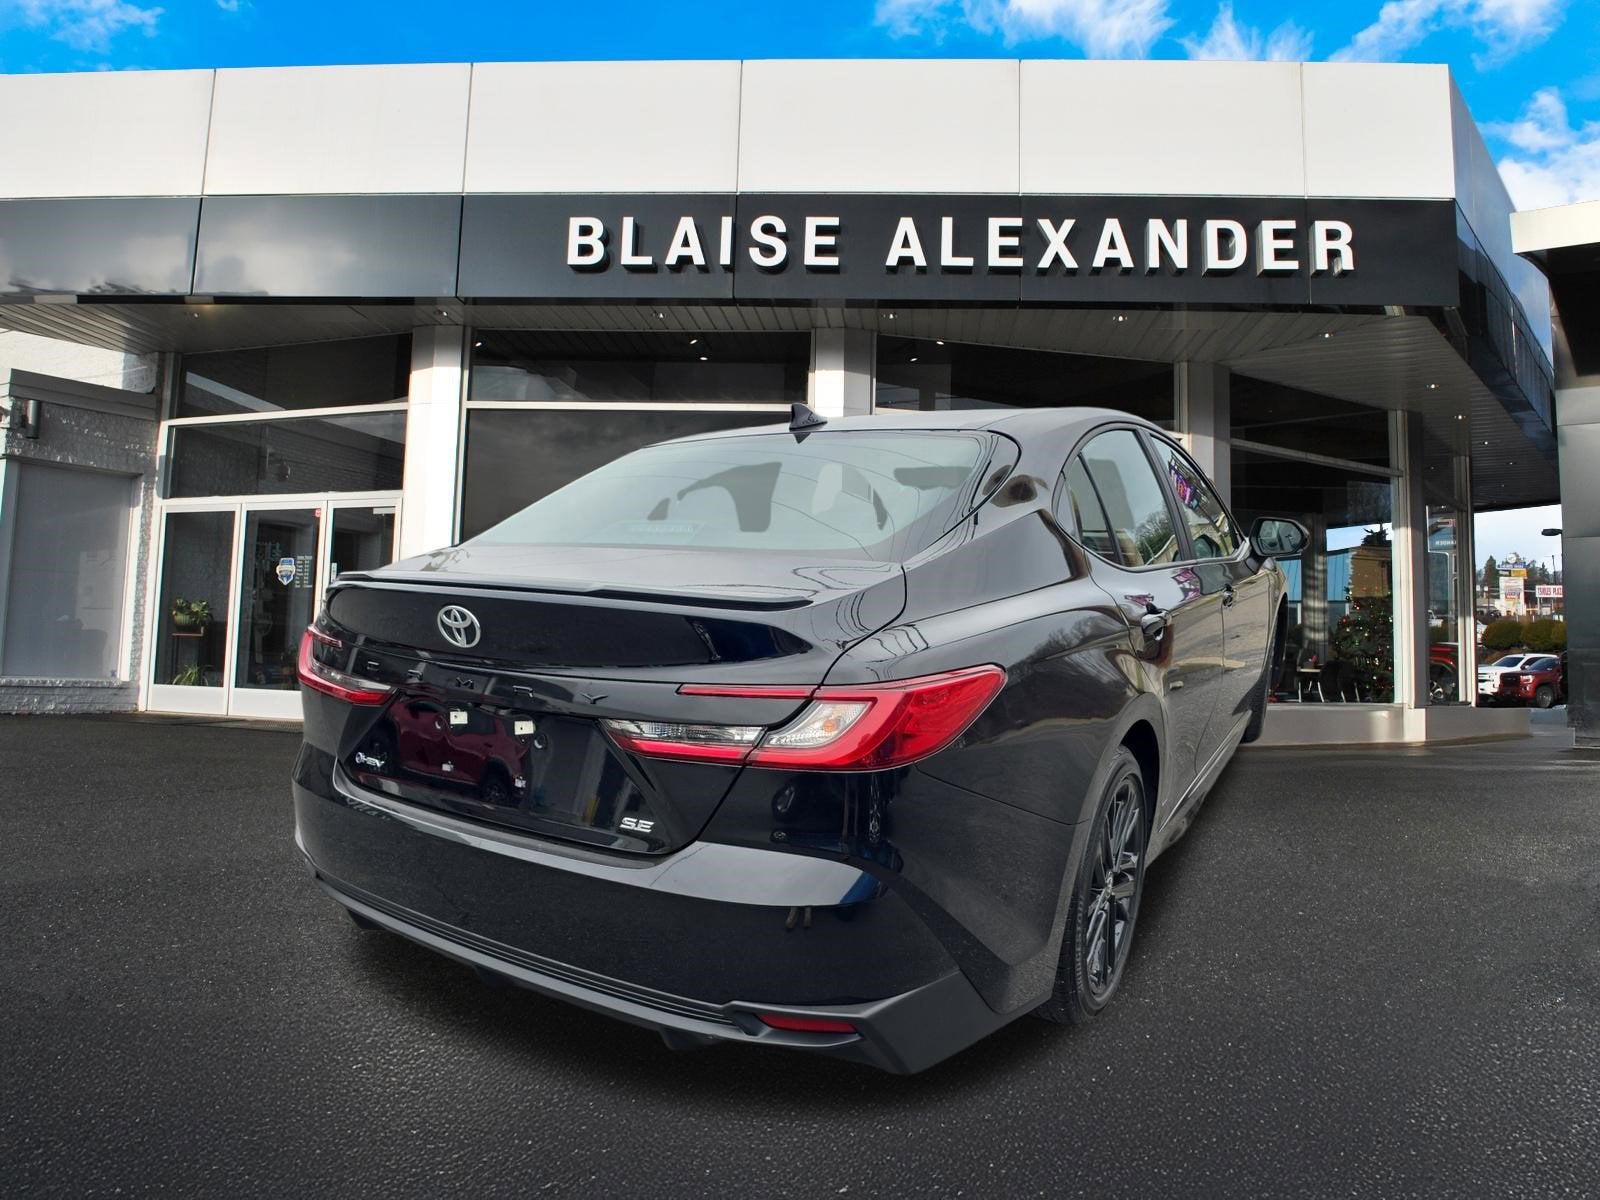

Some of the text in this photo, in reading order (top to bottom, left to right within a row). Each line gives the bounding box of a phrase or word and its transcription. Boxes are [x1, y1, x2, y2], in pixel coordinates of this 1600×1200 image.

[566, 215, 1355, 273] BLAISE ALEXANDER
[619, 816, 655, 833] SE
